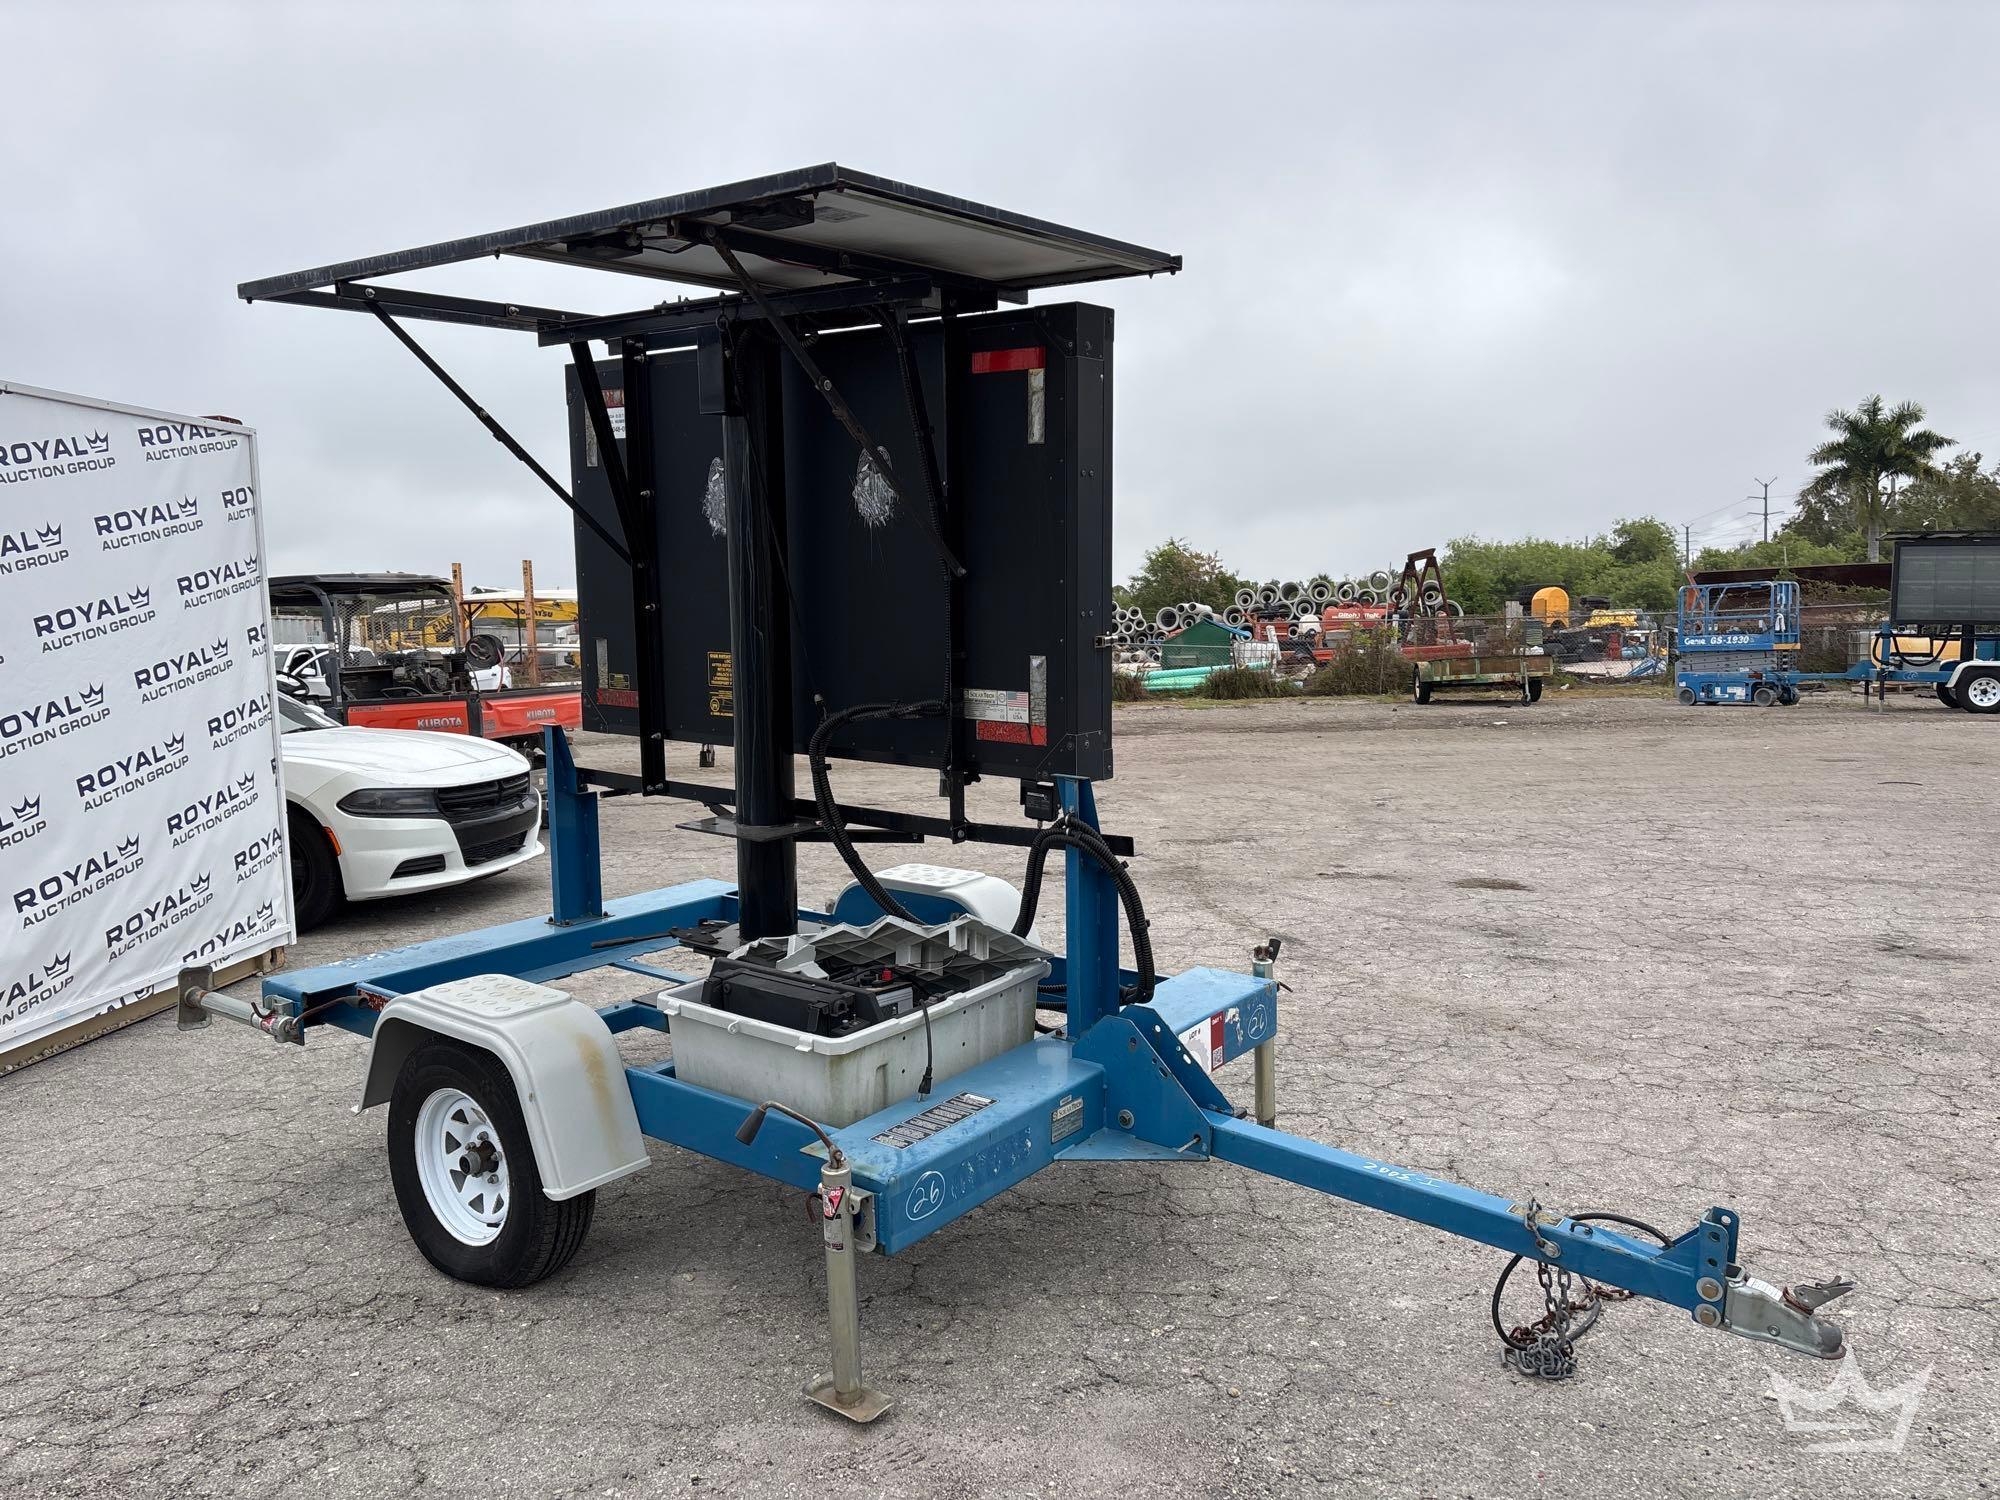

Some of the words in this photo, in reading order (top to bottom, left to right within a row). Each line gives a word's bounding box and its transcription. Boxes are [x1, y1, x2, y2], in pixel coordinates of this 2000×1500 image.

[138, 424, 215, 447] ROYAL
[146, 446, 198, 462] AUCTION
[199, 439, 238, 454] GROUP
[67, 457, 116, 474] GROUP
[94, 503, 180, 536] ROYAL
[102, 529, 161, 551] AUCTION
[162, 519, 204, 538] GROUP
[15, 550, 69, 571] GROUP
[177, 562, 246, 595] ROYAL
[184, 587, 230, 610] AUCTION
[231, 576, 261, 594] GROUP
[33, 595, 130, 637] ROYAL
[42, 625, 107, 653] AUCTION
[109, 610, 156, 632] GROUP
[1684, 637, 1706, 645] Genie
[1710, 635, 1749, 644] GS-1930
[134, 648, 213, 690] ROYAL
[142, 676, 195, 704] AUCTION
[196, 660, 233, 682] GROUP
[0, 696, 82, 738] OYAL
[59, 708, 110, 735] GROUP
[208, 695, 268, 737] ROYAL
[417, 717, 463, 728] KUBOTA
[526, 708, 556, 720] KUBOTA
[213, 721, 257, 750] AUCTION
[76, 746, 166, 797] ROYAL
[84, 777, 145, 812] AUCTION
[147, 755, 189, 783] GROUP
[167, 785, 240, 835] ROYAL
[172, 813, 223, 849] AUCTION
[223, 793, 259, 819] GROUP
[0, 820, 47, 850] ROUP
[234, 828, 281, 871] ROYA
[13, 851, 118, 914] ROYAL
[237, 849, 278, 884] AUCTION
[23, 885, 93, 930] AUCTION
[96, 857, 144, 890] GROUP
[106, 888, 191, 949] ROYAL
[109, 919, 168, 963] AUCTION
[171, 893, 213, 925] GROUP
[17, 975, 74, 1015] GROUP
[1251, 1014, 1264, 1034] 26
[914, 1180, 939, 1213] 26
